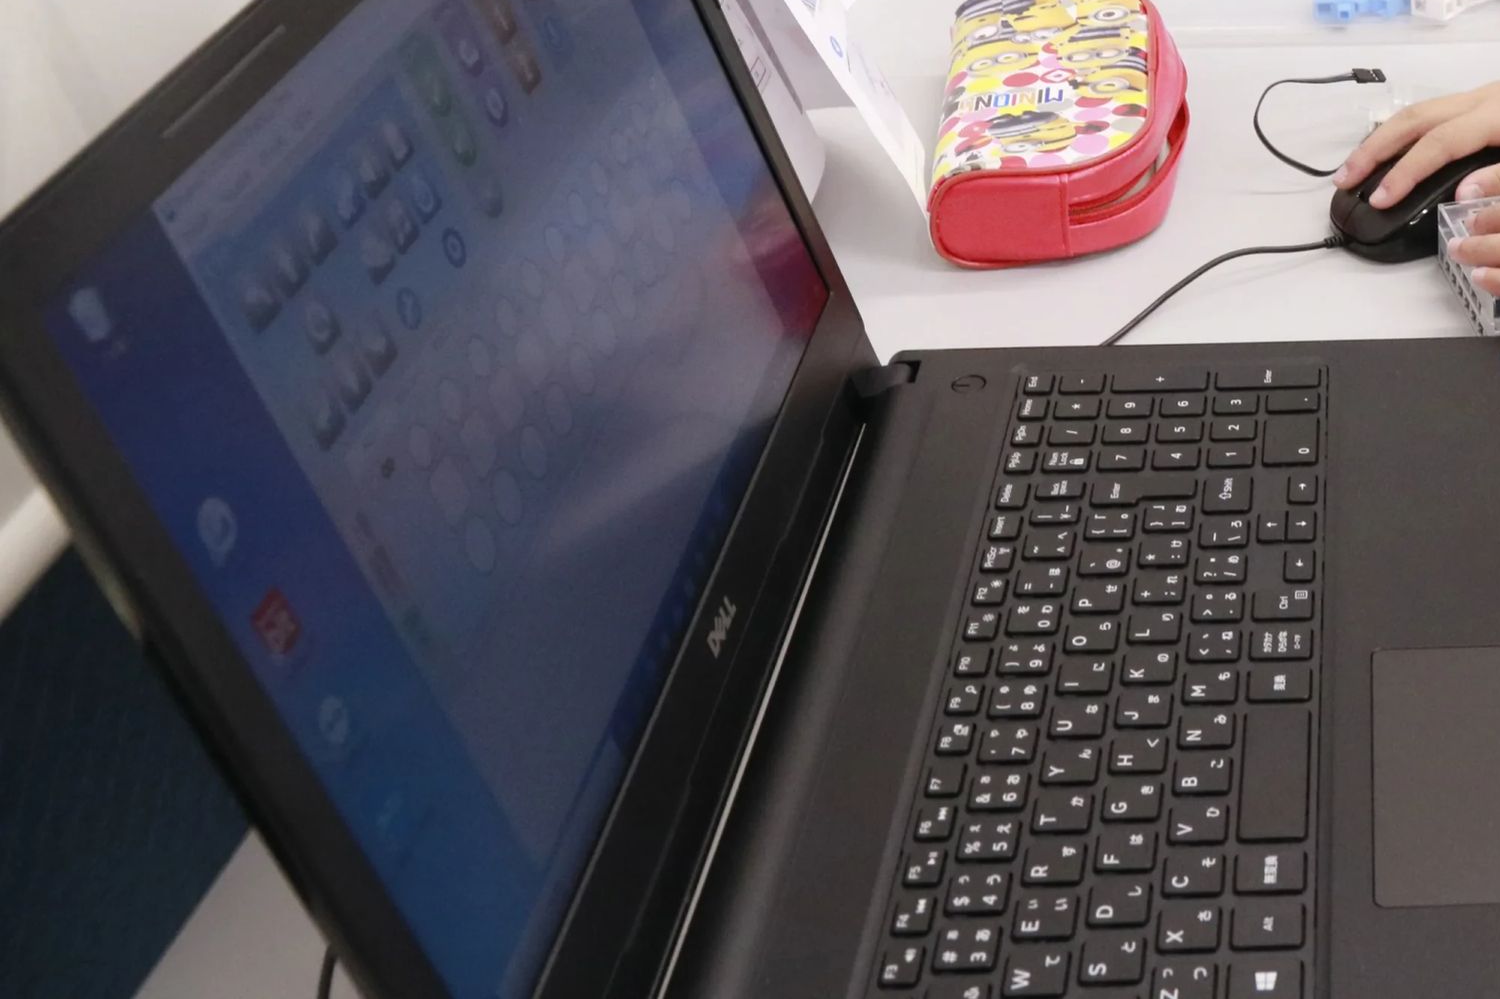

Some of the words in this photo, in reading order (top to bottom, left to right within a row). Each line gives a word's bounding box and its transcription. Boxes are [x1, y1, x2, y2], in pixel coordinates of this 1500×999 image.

[1109, 482, 1121, 500] Enter
[1078, 598, 1093, 608] P
[706, 594, 737, 660] DELL
[1134, 628, 1151, 637] L
[1071, 635, 1088, 647] O
[1128, 668, 1145, 679] K
[1190, 684, 1207, 697] M
[1123, 710, 1140, 721] J
[1055, 719, 1073, 732] U
[1185, 729, 1203, 742] N
[1116, 754, 1134, 767] H
[1047, 765, 1065, 777] Y
[929, 777, 942, 791] F7
[1180, 776, 1199, 788] B
[1110, 801, 1128, 814] G
[1039, 813, 1057, 826] T
[1175, 823, 1194, 836] V
[1102, 853, 1120, 865] F
[907, 865, 922, 880] F5
[1029, 865, 1049, 878] R
[1171, 875, 1190, 889] C
[1095, 904, 1114, 919] D
[895, 913, 910, 929] F4
[1020, 919, 1041, 933] E
[1165, 929, 1185, 944] X
[883, 964, 899, 980] F3
[1087, 962, 1108, 977] S
[1010, 968, 1031, 991] W
